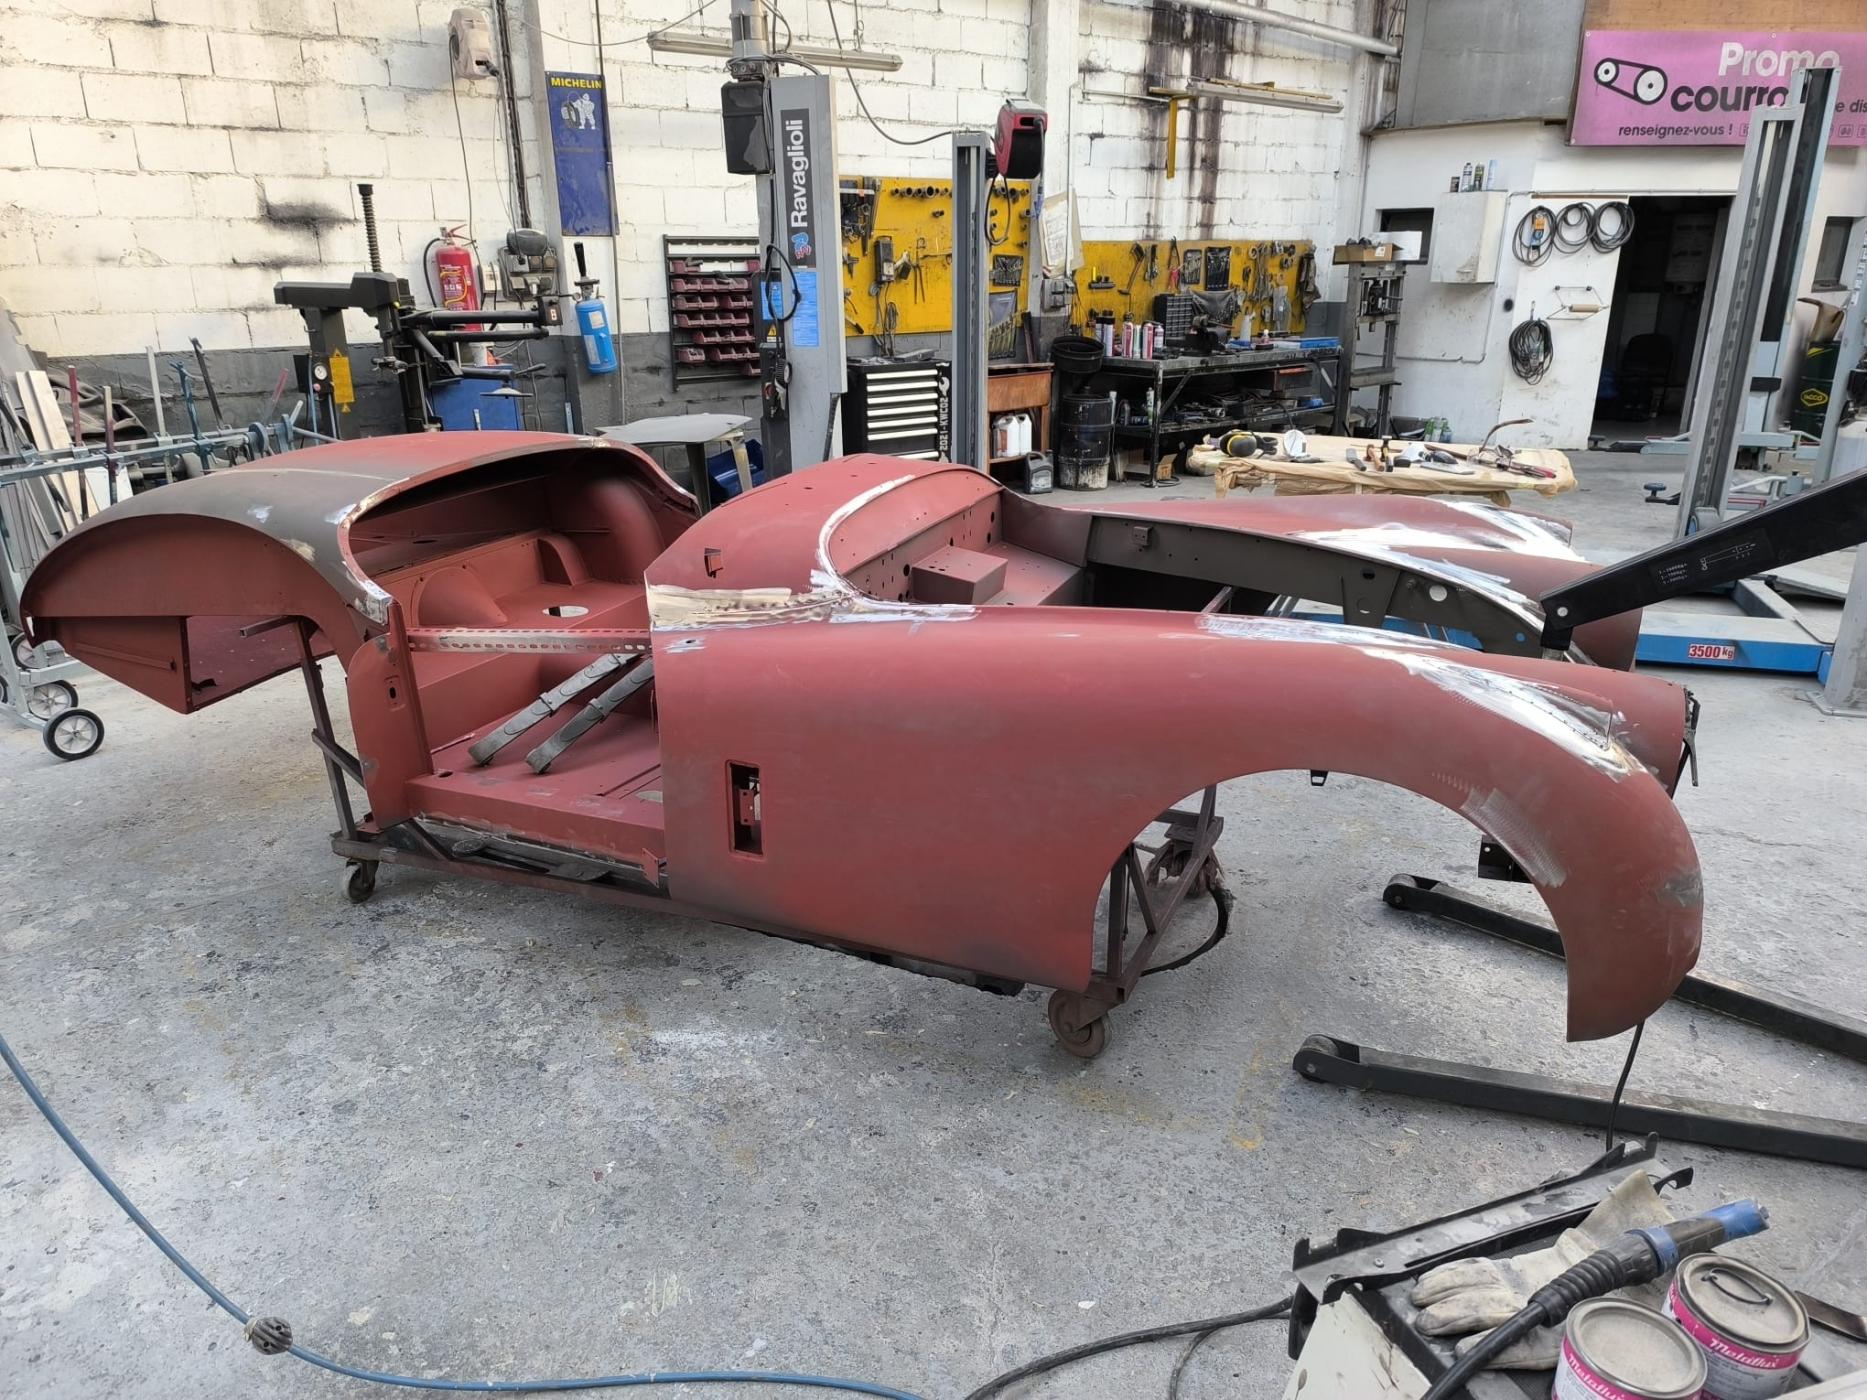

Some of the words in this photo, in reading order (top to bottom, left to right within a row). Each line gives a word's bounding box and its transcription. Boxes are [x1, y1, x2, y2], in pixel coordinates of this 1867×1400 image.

[1718, 42, 1840, 77] Promo
[551, 77, 602, 88] MICHELIN
[1670, 85, 1789, 112] courro
[1618, 125, 1724, 139] renseignez-vous
[786, 119, 808, 228] Ravaglioli
[1690, 645, 1721, 658] 3500
